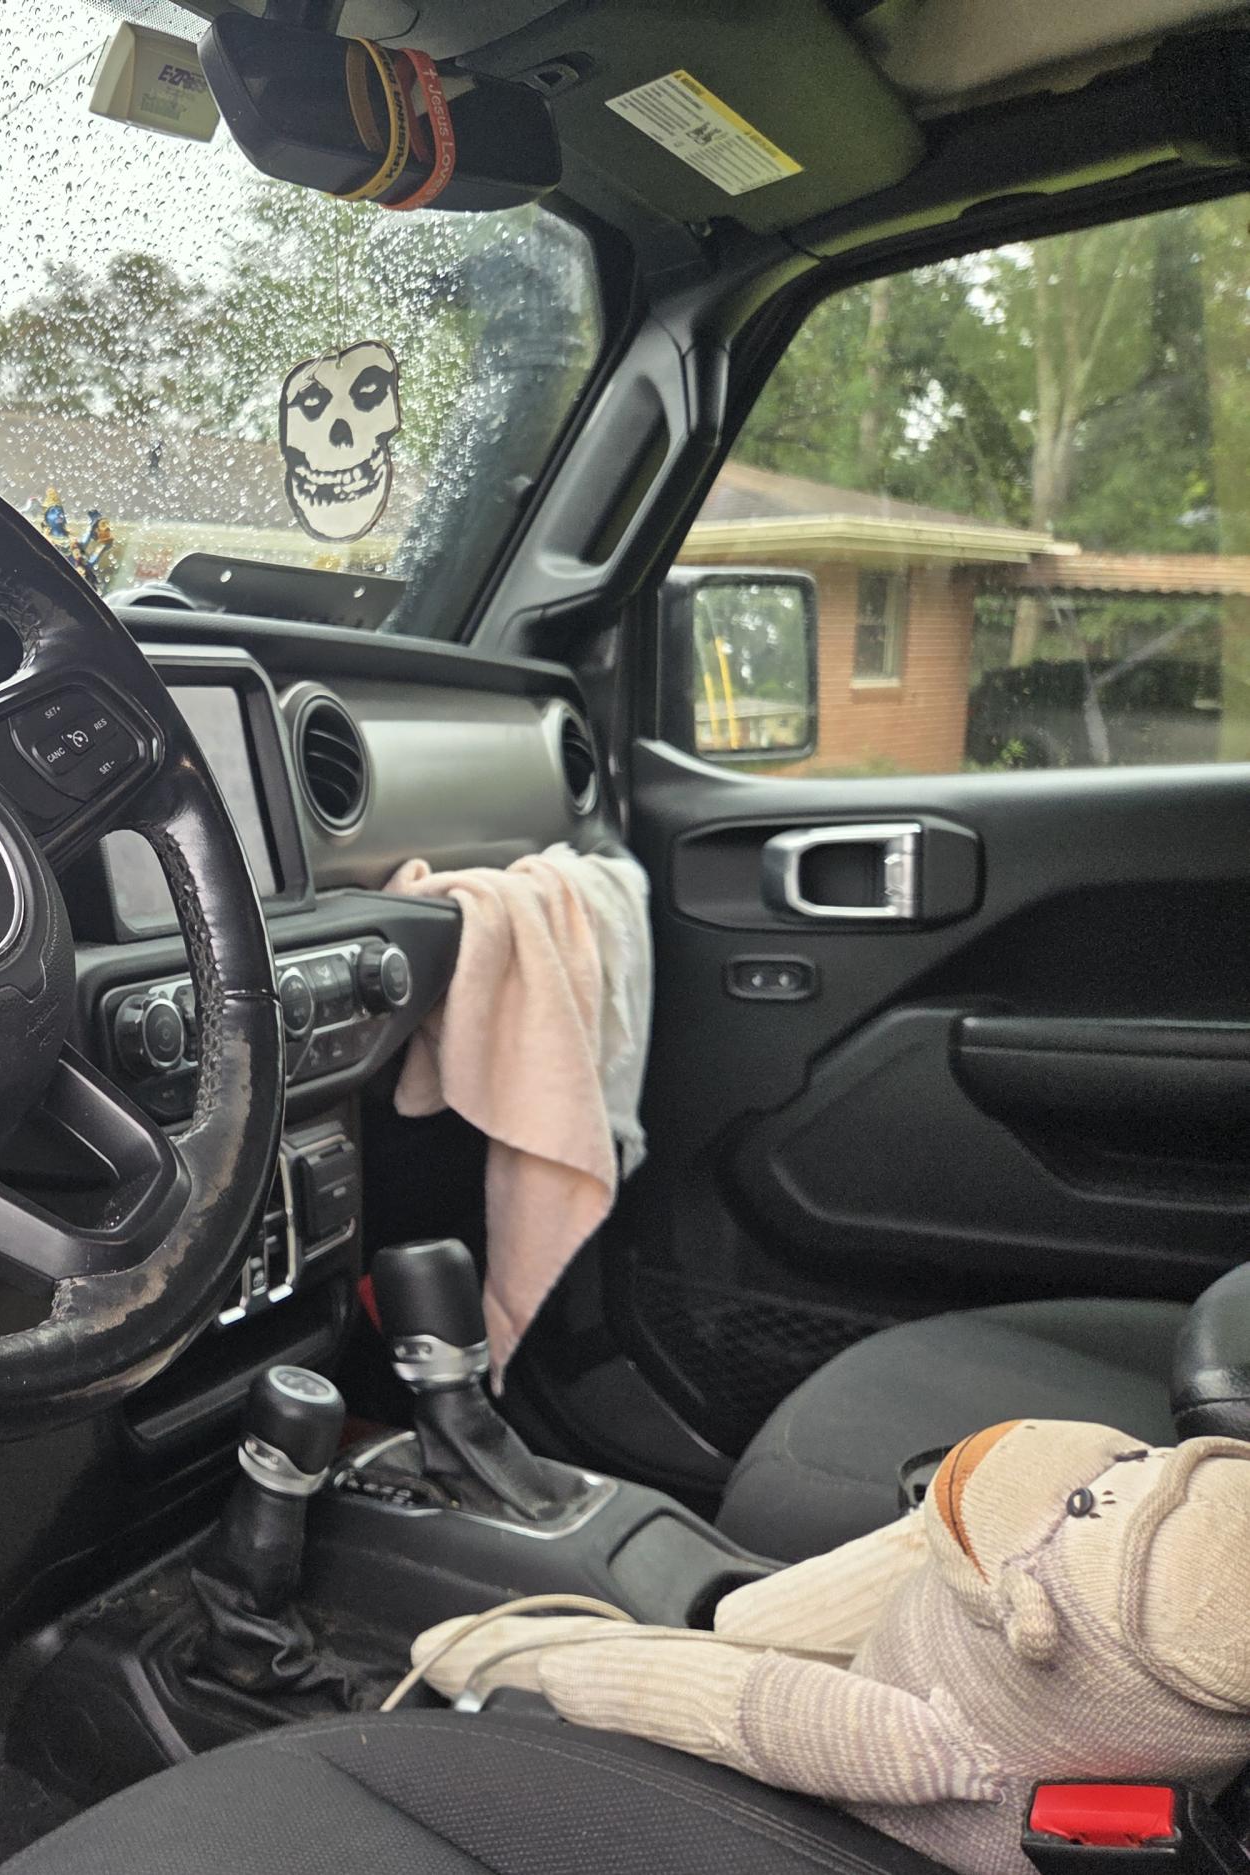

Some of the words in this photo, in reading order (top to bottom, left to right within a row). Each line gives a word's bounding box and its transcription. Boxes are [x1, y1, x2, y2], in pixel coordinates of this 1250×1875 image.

[428, 83, 449, 137] Jesus
[93, 718, 108, 731] RES
[46, 747, 66, 763] CANC
